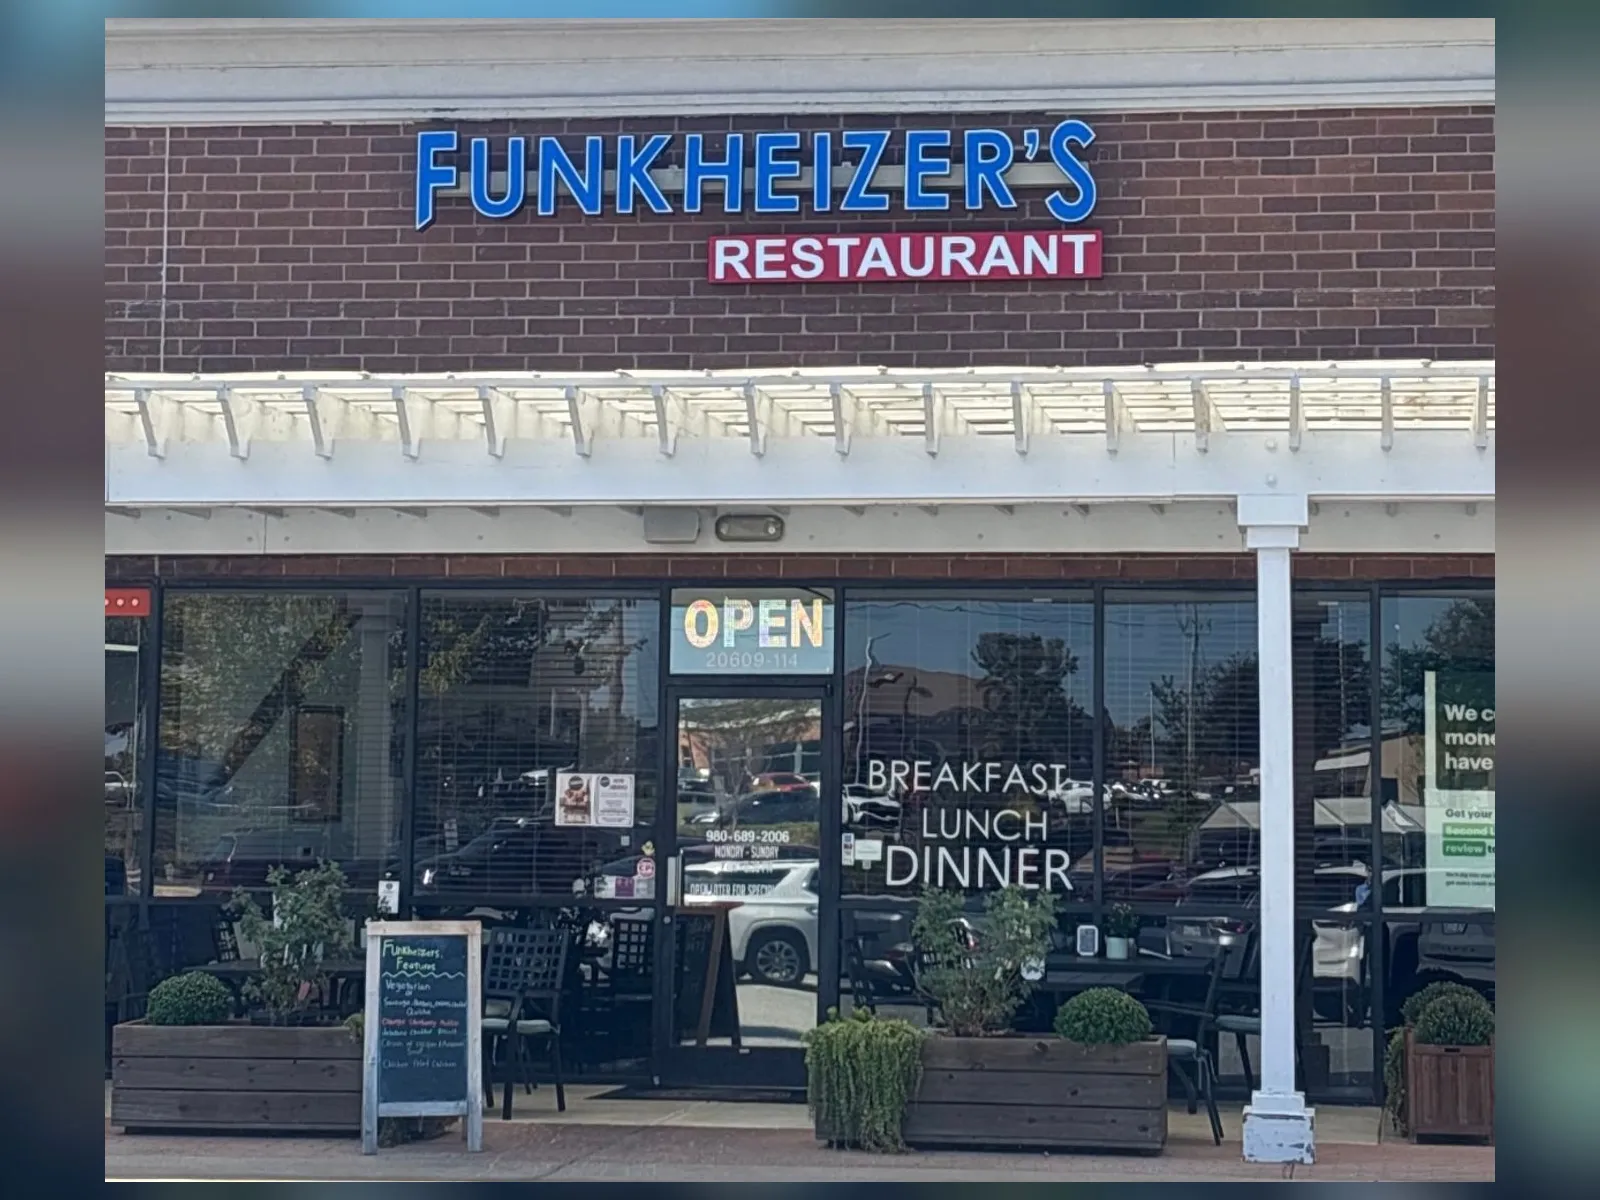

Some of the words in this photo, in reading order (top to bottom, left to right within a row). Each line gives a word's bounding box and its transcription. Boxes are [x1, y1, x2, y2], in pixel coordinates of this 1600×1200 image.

[415, 118, 1098, 231] FUNKHEIZER'S
[714, 233, 1097, 280] RESTAURANT
[684, 597, 823, 648] OPEN
[706, 652, 798, 667] 20609-114
[1444, 704, 1478, 721] We
[1481, 708, 1495, 721] c
[1445, 752, 1494, 770] have
[869, 760, 1066, 794] BREAKFAST
[1445, 808, 1465, 818] Get
[1468, 809, 1493, 819] your
[923, 808, 1047, 841] LUNCH
[706, 830, 790, 843] 980-689-2006
[714, 845, 744, 858] MONDAY
[751, 845, 779, 858] SUNDAY
[1445, 842, 1483, 853] review
[886, 845, 1074, 891] DINNER
